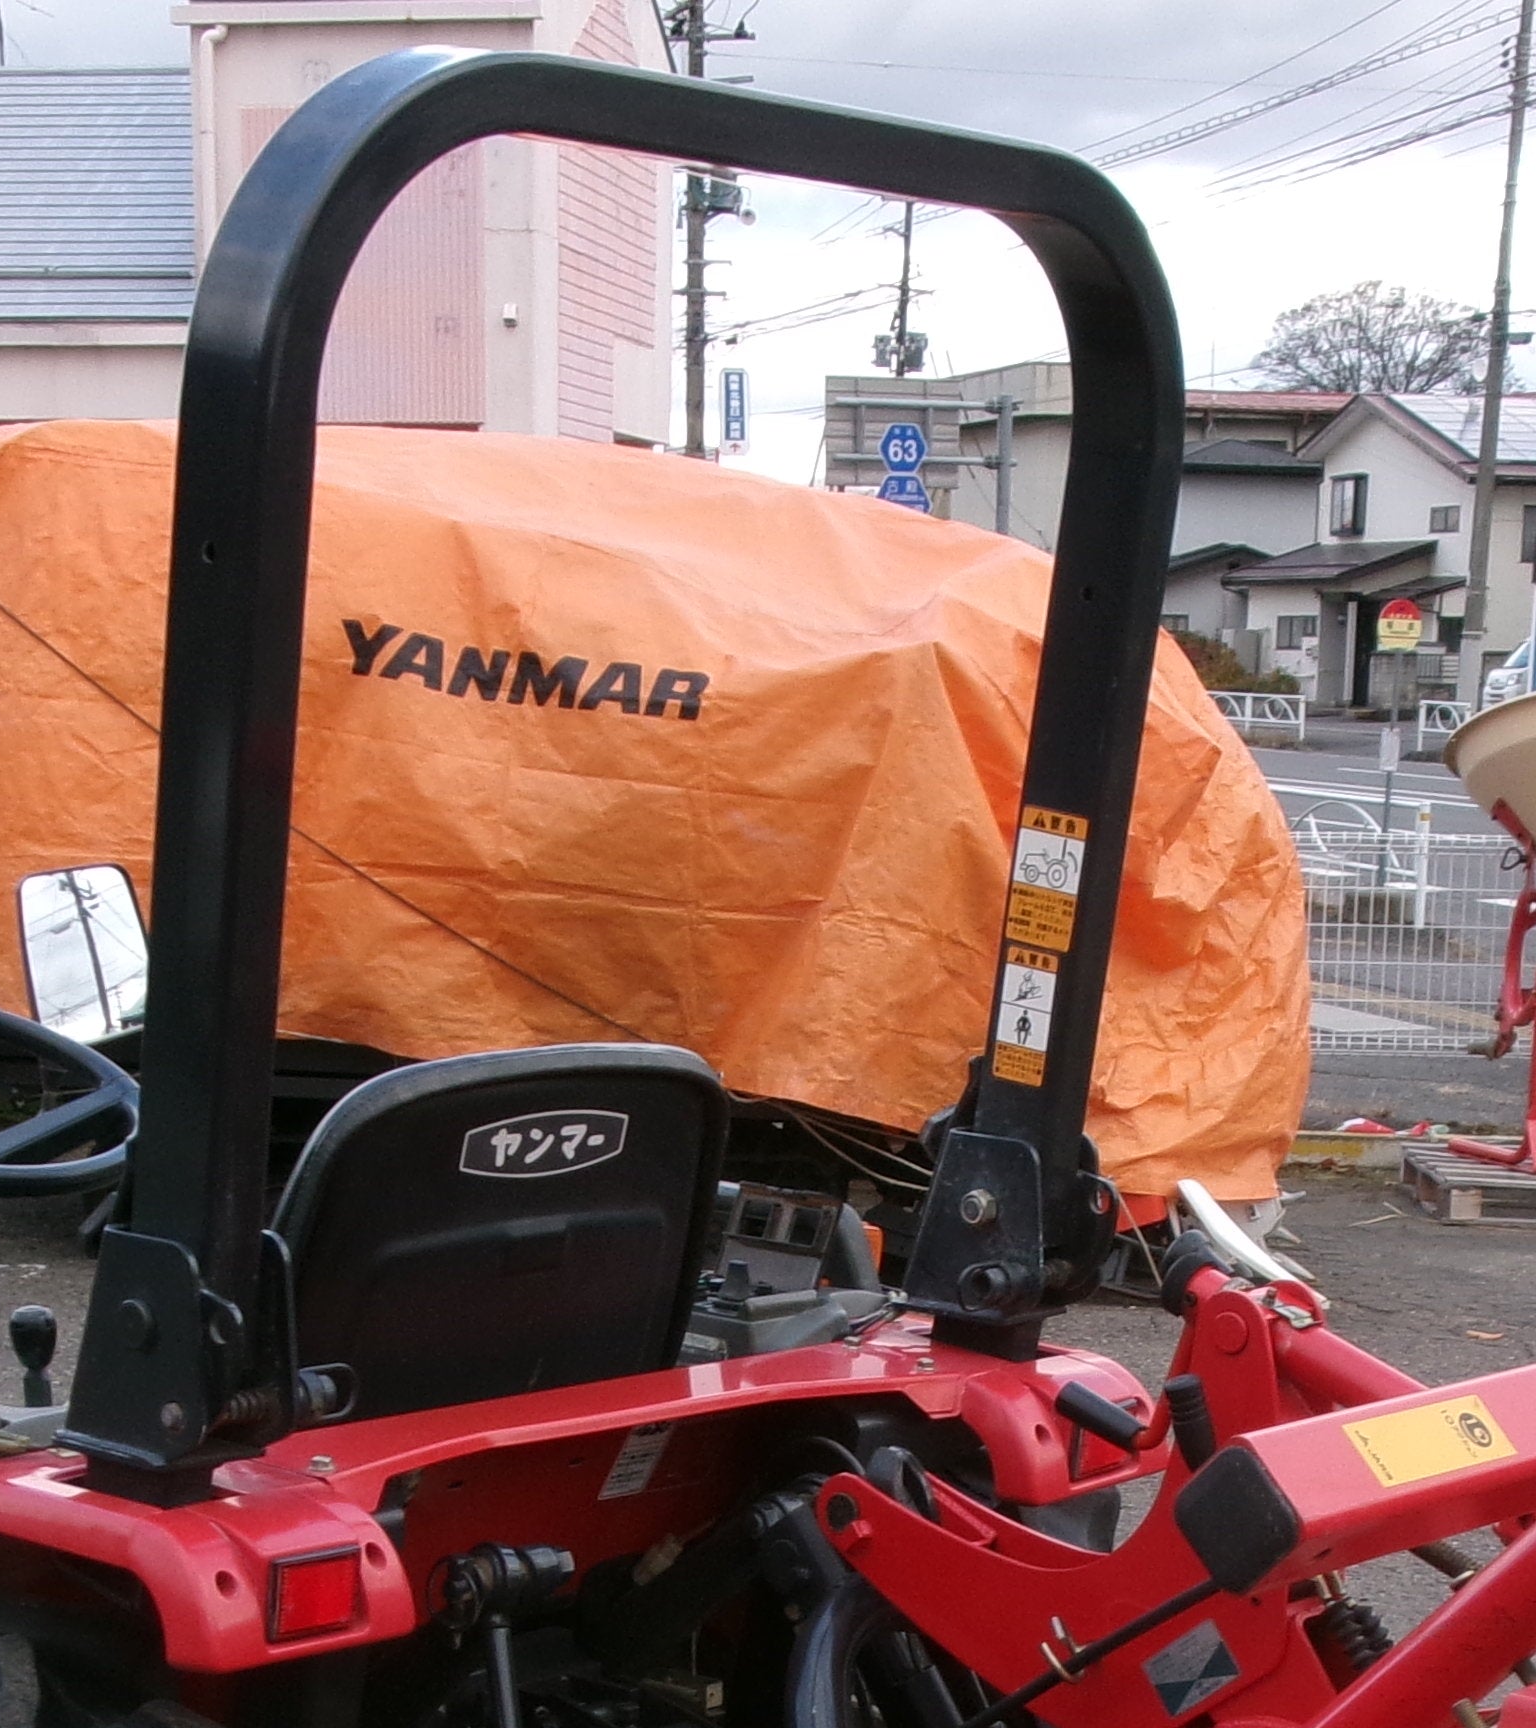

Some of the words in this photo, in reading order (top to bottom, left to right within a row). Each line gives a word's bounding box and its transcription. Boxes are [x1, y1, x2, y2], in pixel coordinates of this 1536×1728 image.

[888, 439, 918, 462] 63
[341, 618, 711, 721] YANMAR
[490, 1124, 606, 1168] ヤンマー
